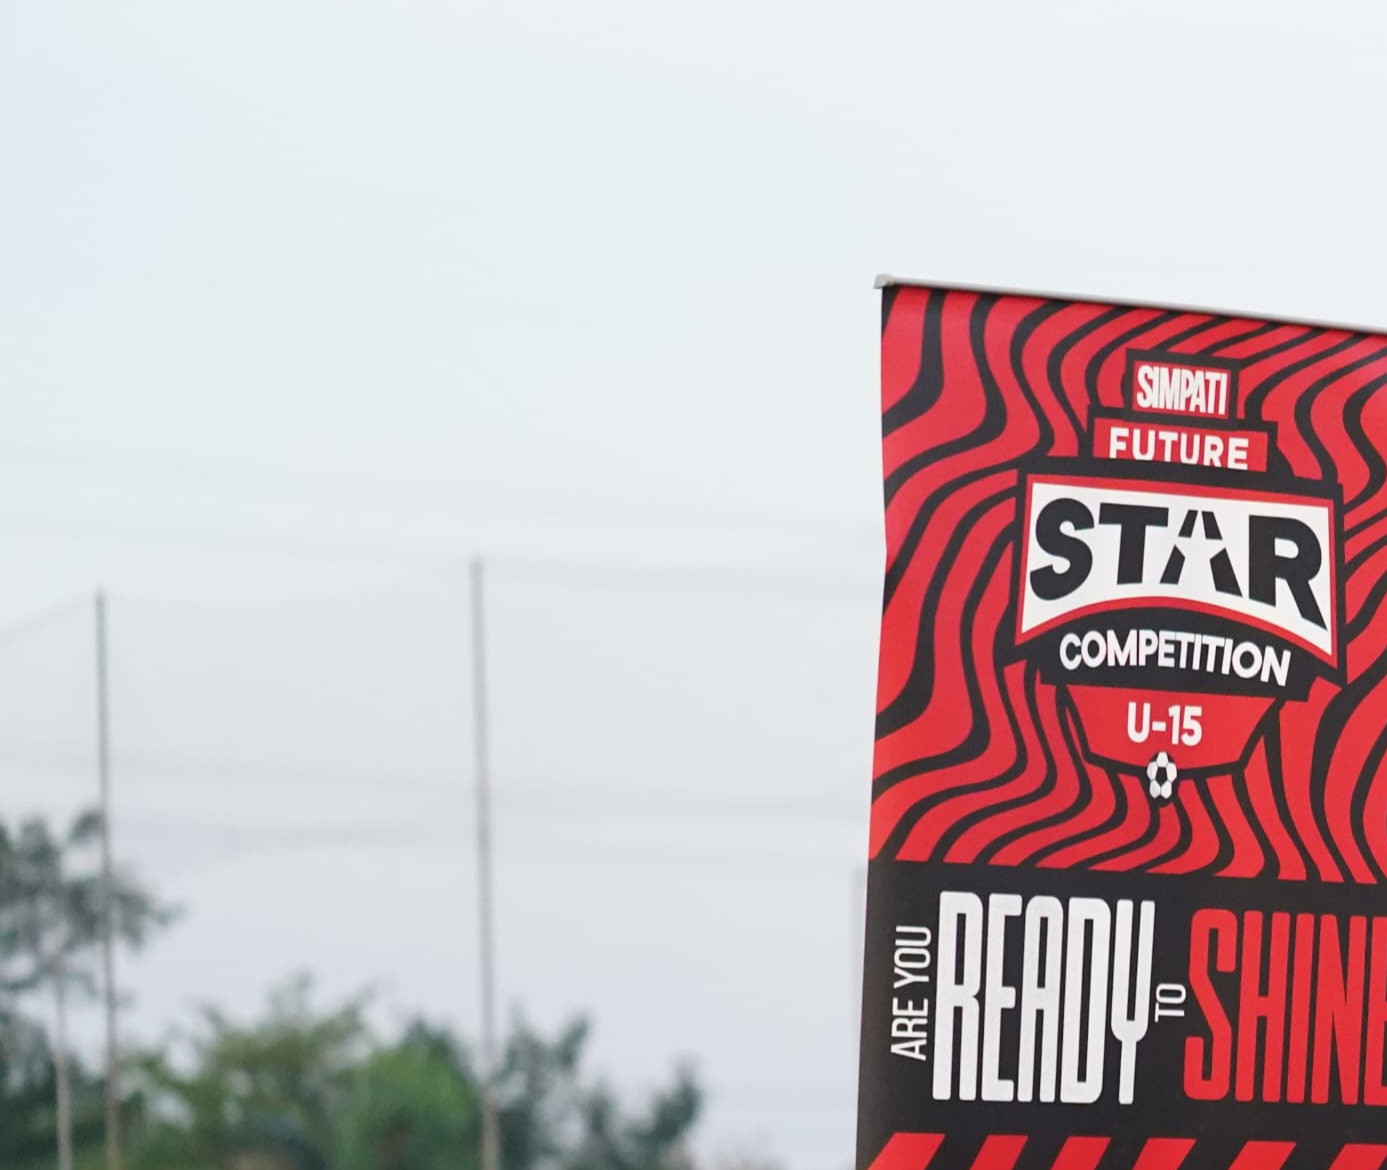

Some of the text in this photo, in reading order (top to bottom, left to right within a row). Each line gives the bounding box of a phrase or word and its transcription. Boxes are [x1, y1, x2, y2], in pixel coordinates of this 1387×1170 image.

[1136, 364, 1228, 416] SIMPATI
[1109, 426, 1250, 470] FUTURE
[1029, 497, 1328, 632] STAR
[1059, 629, 1291, 687] COMPETITION
[1126, 701, 1203, 747] U-15
[893, 925, 932, 989] YOU
[932, 891, 1156, 1105] READY
[1154, 983, 1187, 1022] TO
[890, 997, 927, 1061] ARE
